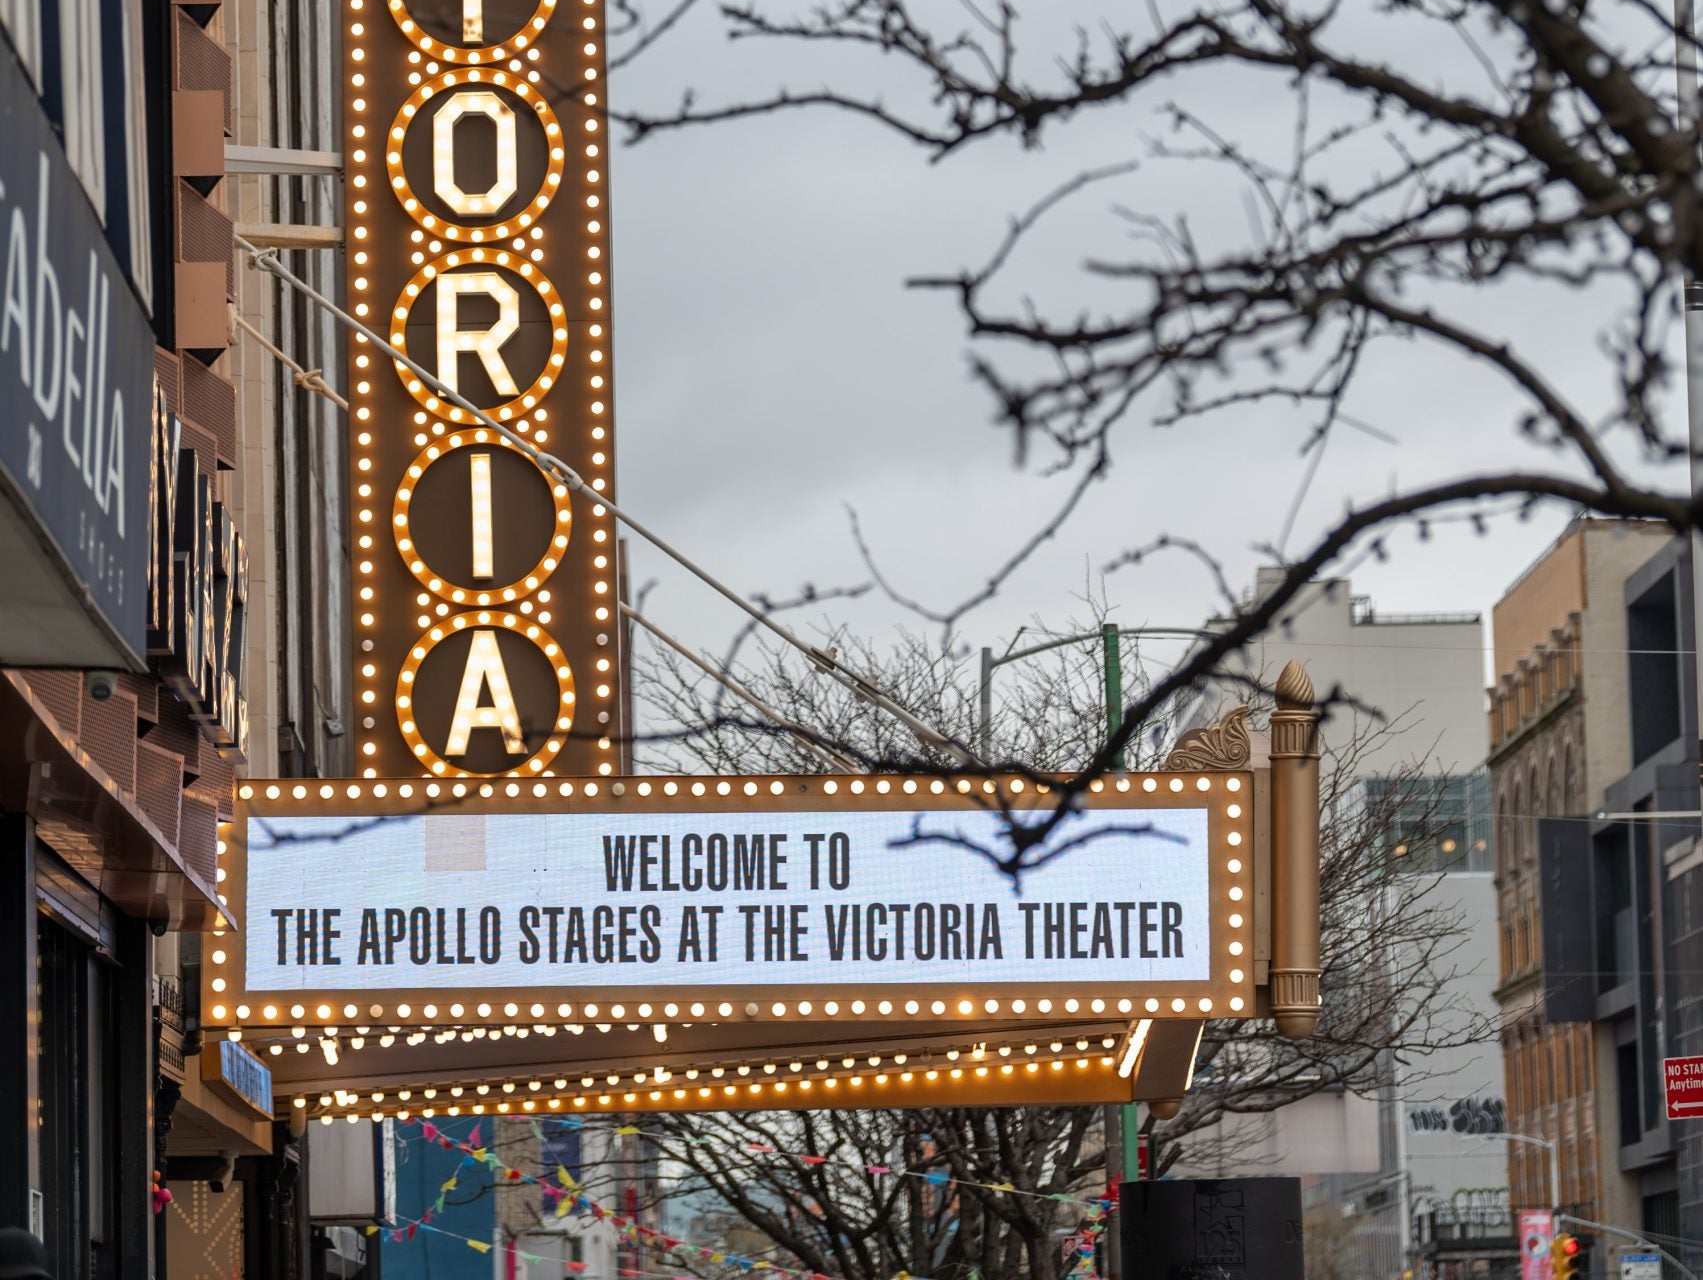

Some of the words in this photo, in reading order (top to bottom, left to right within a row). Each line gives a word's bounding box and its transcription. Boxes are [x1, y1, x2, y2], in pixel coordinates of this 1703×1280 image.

[602, 833, 786, 892] WELCOME
[803, 831, 850, 890] TO
[270, 908, 340, 966] THE
[357, 906, 500, 965] APOLLO
[519, 905, 660, 964] STAGES
[678, 904, 723, 962] AT
[738, 904, 807, 962] THE
[824, 902, 1002, 961] VICTORIA
[1018, 901, 1183, 959] THEATER
[1668, 1064, 1681, 1077] NO
